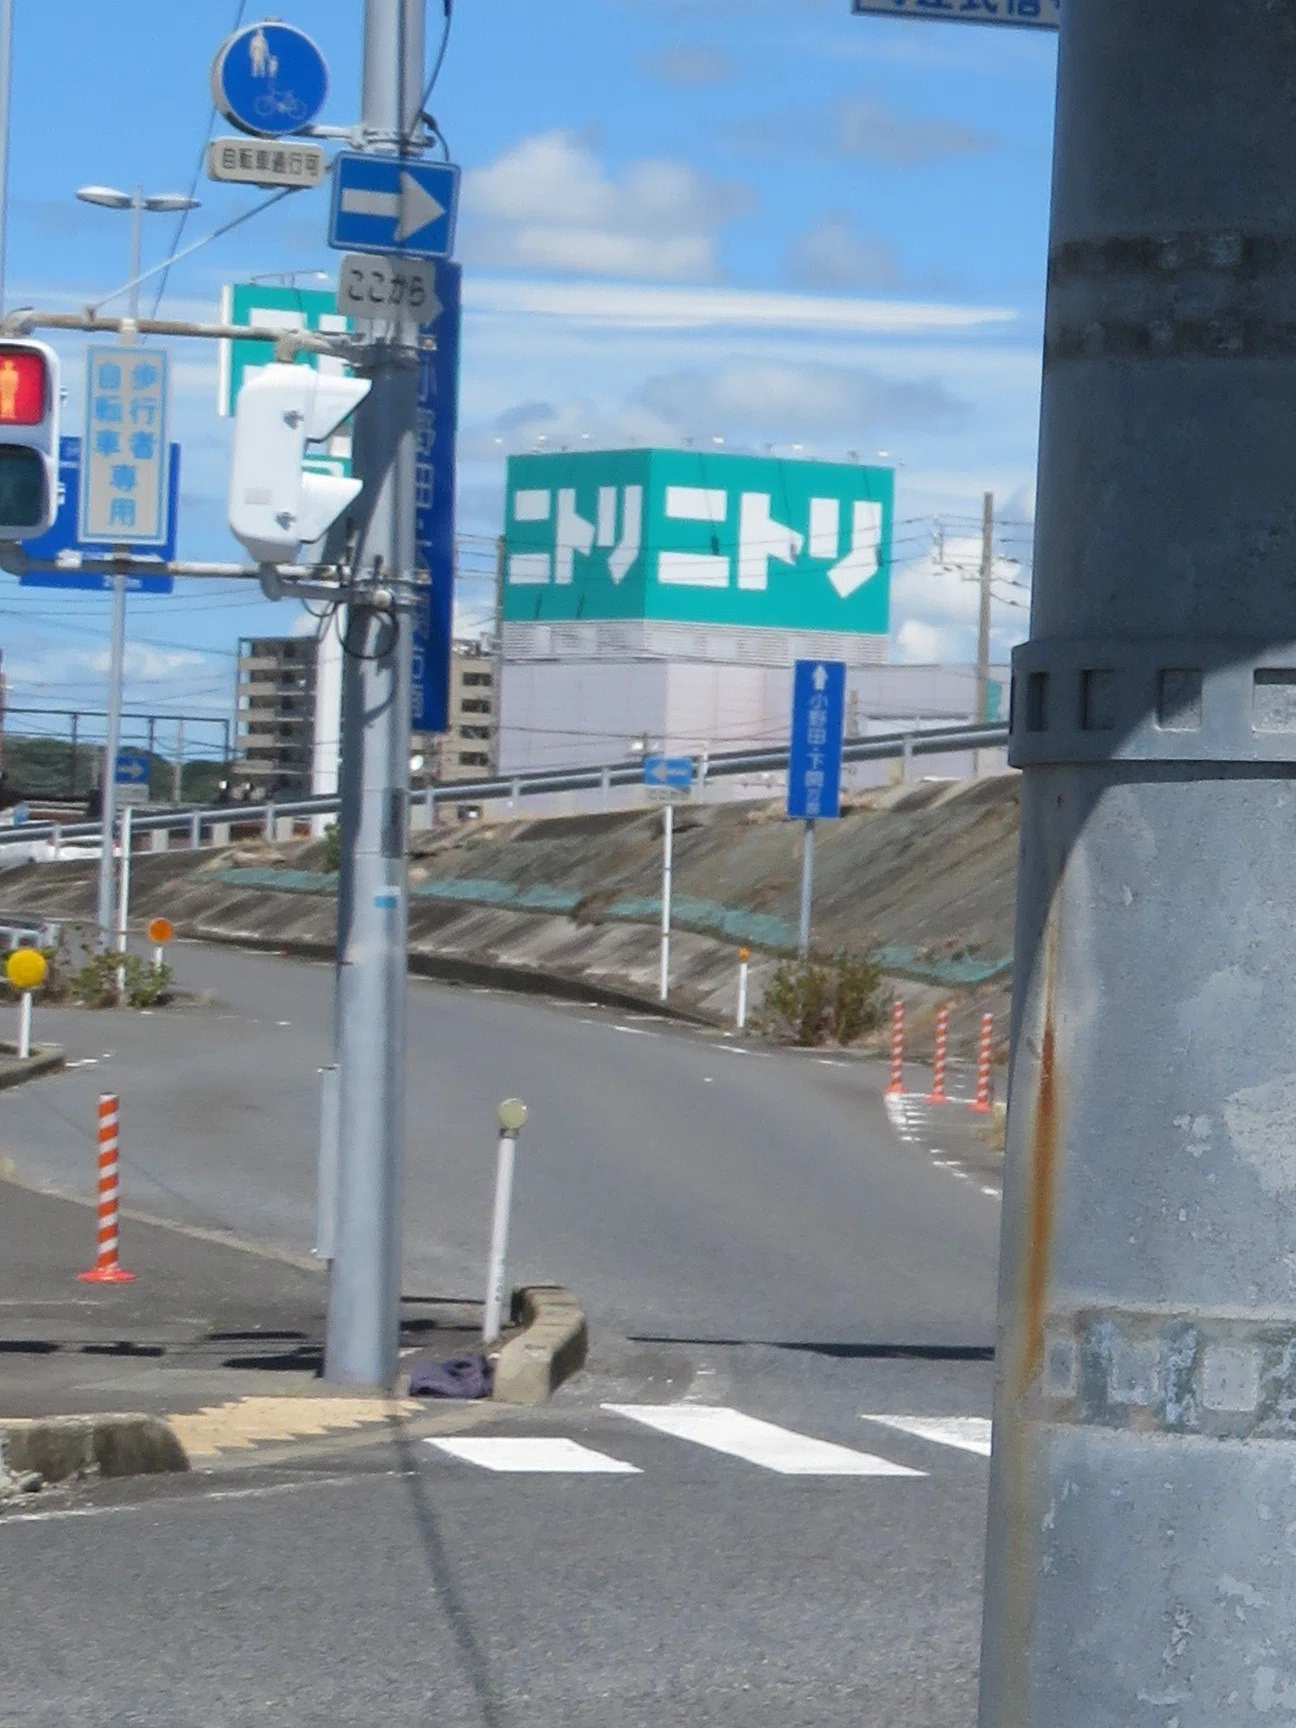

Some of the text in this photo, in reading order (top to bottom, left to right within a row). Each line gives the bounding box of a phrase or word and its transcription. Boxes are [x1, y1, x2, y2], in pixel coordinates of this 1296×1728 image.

[508, 484, 642, 585] ニトリ
[658, 485, 883, 599] ニトリ
